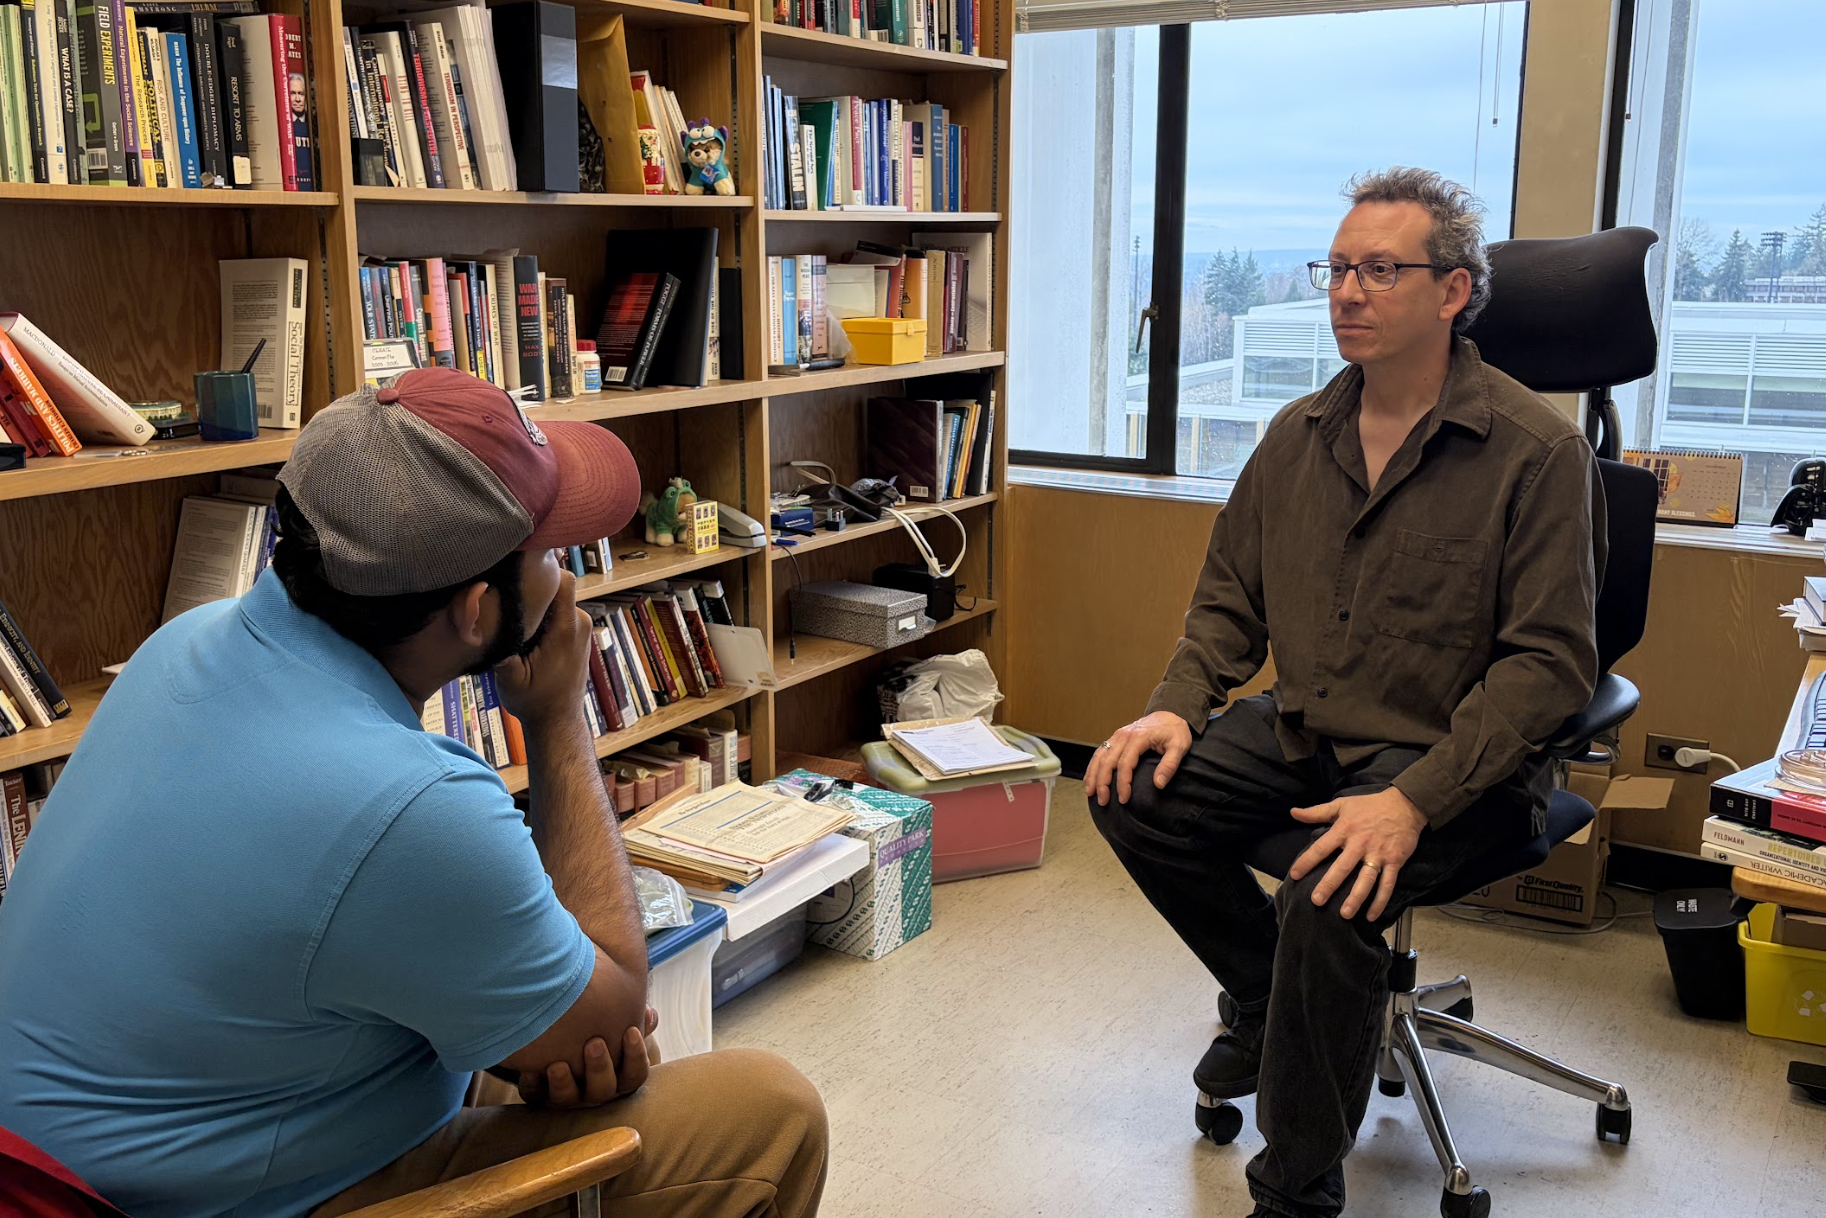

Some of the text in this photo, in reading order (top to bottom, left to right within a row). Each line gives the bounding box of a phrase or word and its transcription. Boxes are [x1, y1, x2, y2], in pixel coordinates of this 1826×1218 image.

[98, 5, 115, 85] FIELD EXPERIMENTS
[61, 48, 71, 71] WHAT
[65, 89, 73, 113] CASE?
[204, 43, 220, 151] DOUBLE-EDGED DIPLOMACY
[231, 77, 243, 141] RESORT TO ARMS
[367, 73, 384, 125] International
[372, 57, 386, 116] Contemporary
[383, 121, 393, 150] Theory
[398, 75, 410, 94] DYING
[404, 108, 414, 122] KILL
[413, 53, 428, 100] TERRORISM
[422, 107, 438, 156] PERSPECTIVE
[137, 89, 145, 118] Research
[141, 120, 149, 144] Process
[147, 80, 161, 144] POLITICAL
[157, 79, 165, 95] RISK
[162, 113, 170, 142] CULTURE
[444, 72, 455, 105] TERRORISM
[452, 114, 464, 150] PERSPECTIVE
[787, 142, 804, 192] STALIN
[518, 295, 539, 305] MADE
[519, 283, 537, 294] WAR
[660, 283, 671, 305] POGGI
[365, 301, 373, 318] YOUR
[385, 295, 393, 322] UNIFYING
[521, 306, 538, 317] NEW
[652, 308, 662, 331] FORMS
[415, 308, 428, 362] Congress Resurgent
[493, 321, 497, 330] OF
[21, 326, 56, 357] MACDONALD
[640, 342, 652, 365] POWER
[287, 321, 300, 405] Social Theory
[7, 356, 75, 453] POLITICS AND MARKETS
[62, 426, 80, 449] CHARLES
[239, 550, 248, 575] QUARTERLY
[648, 625, 658, 643] Terror
[660, 659, 672, 682] Internet
[474, 687, 490, 737] ANALYTIC NARRATIVES
[5, 778, 22, 786] Tucker
[11, 794, 21, 815] The
[879, 829, 924, 858] QUALITY PARK
[1713, 831, 1744, 845] FELDMANN
[1759, 850, 1791, 863] ORGANIZATIONAL
[1792, 858, 1809, 867] IDENTITY
[1767, 842, 1820, 864] REPERTOIRES
[1750, 861, 1782, 875] WRITER
[1676, 900, 1685, 912] ONLY
[1688, 898, 1697, 912] WASTE
